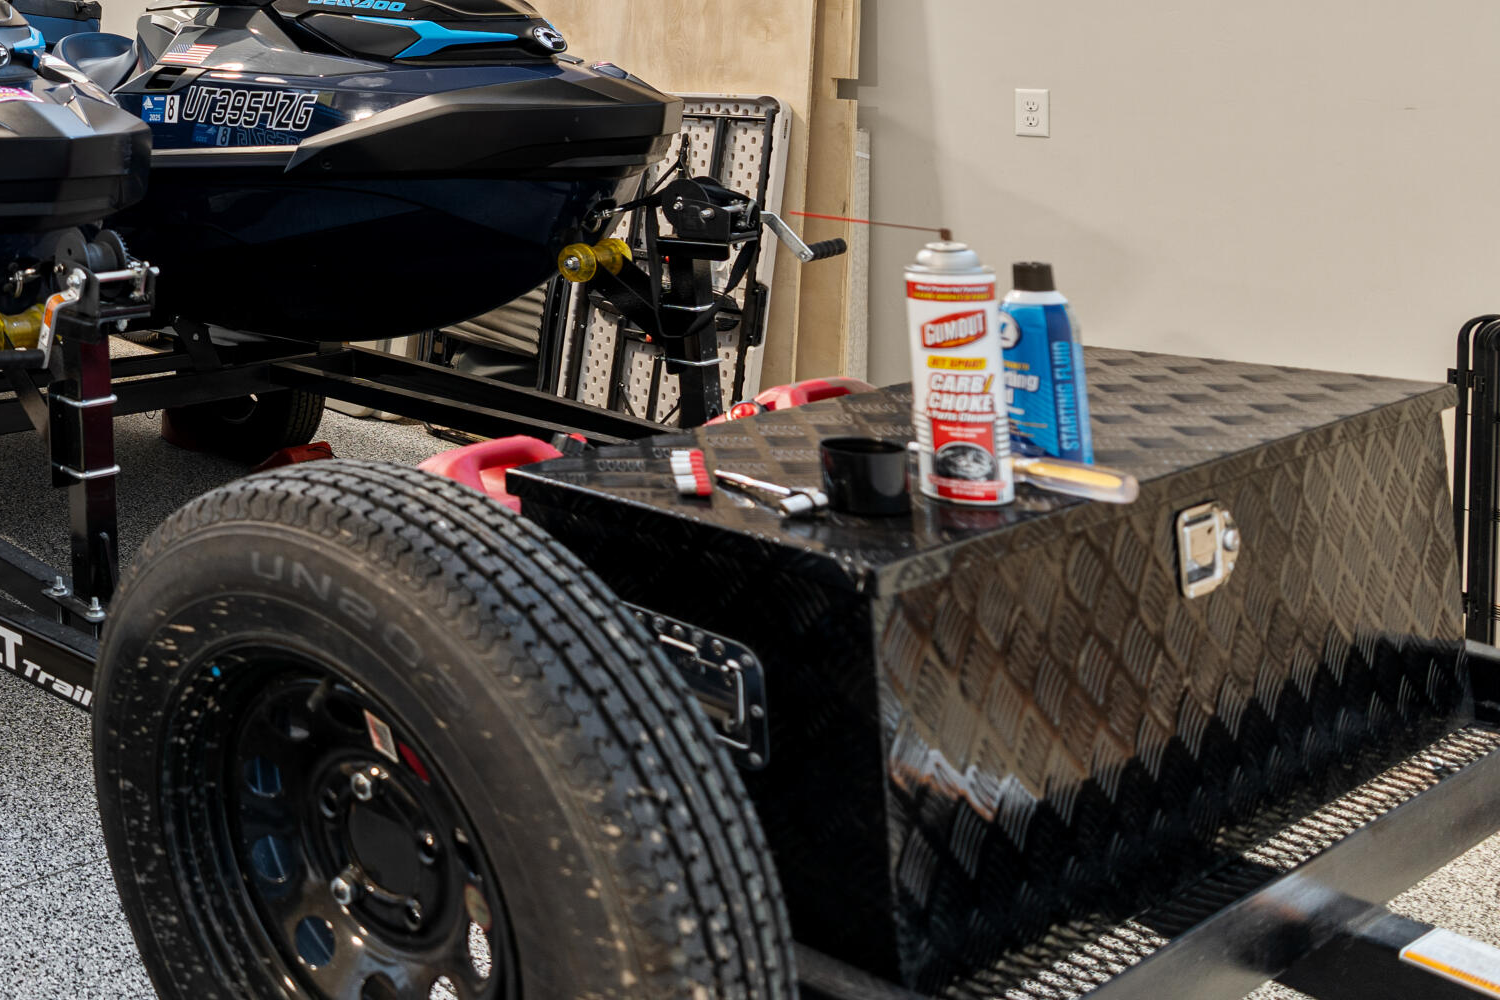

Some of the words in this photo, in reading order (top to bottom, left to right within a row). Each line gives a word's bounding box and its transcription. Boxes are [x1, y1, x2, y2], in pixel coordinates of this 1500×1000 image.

[167, 96, 175, 121] 8
[183, 85, 319, 132] UT3954ZG
[924, 312, 984, 346] GUMOUT
[1052, 341, 1072, 380] FLUID
[931, 373, 994, 394] CARB/
[929, 391, 994, 413] CHOKE
[1055, 383, 1080, 451] STARTING
[22, 658, 92, 708] Trail
